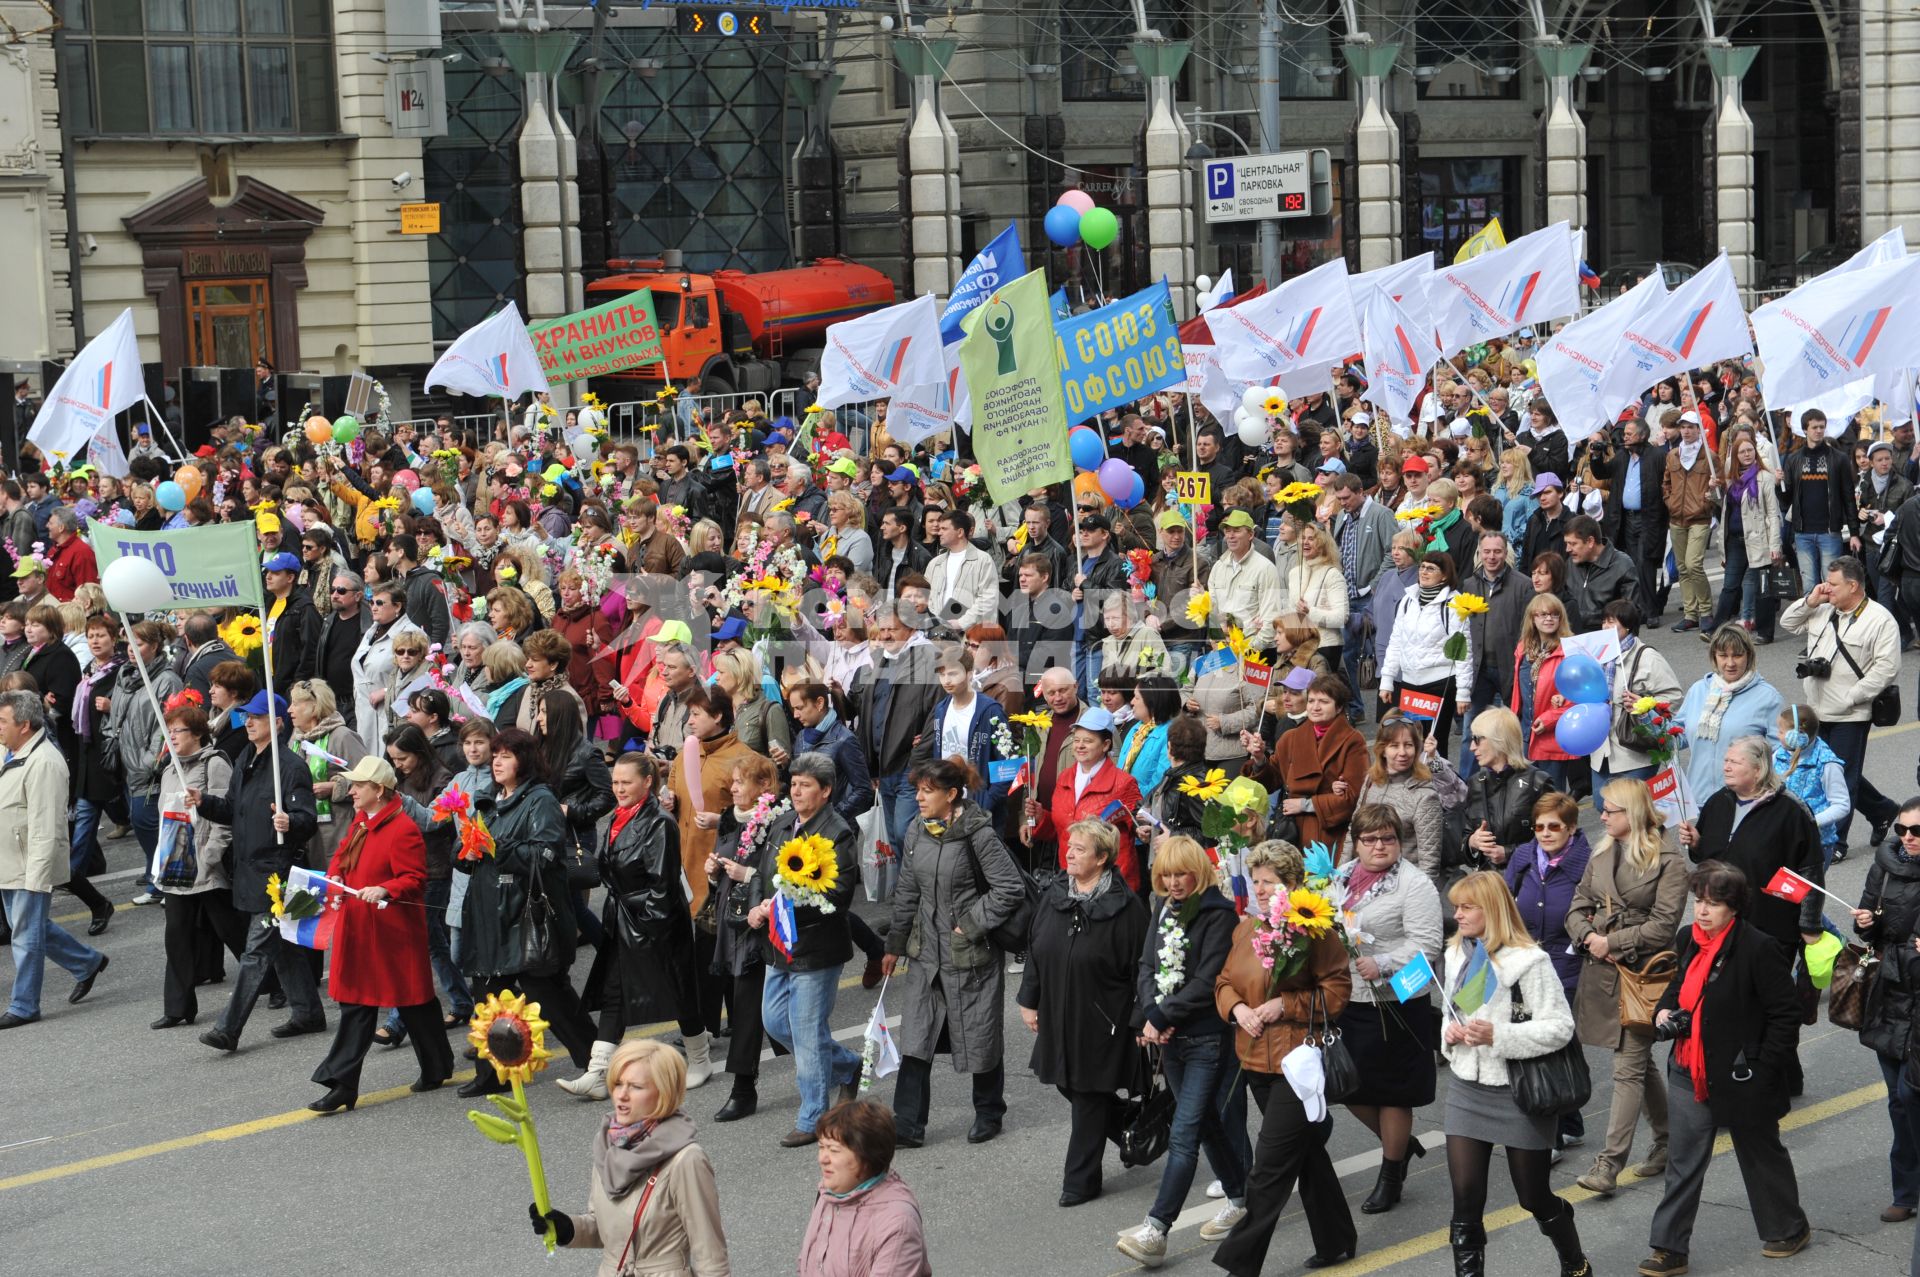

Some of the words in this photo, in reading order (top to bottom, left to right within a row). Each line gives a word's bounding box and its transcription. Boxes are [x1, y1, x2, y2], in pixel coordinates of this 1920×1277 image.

[1240, 180, 1283, 192] ПАРКОВКА
[1239, 196, 1273, 206] СВОБОДНЫХ
[1285, 195, 1303, 209] 192
[530, 304, 647, 352] ХРАНИТЬ
[1075, 304, 1156, 364] СОЮЗ
[562, 349, 578, 365] И
[579, 325, 657, 361] ВНУКОВ
[575, 362, 610, 378] БАЗЫ
[611, 345, 662, 369] ОТДЫХА
[1179, 476, 1207, 498] 267
[1246, 666, 1268, 681] МАЯ
[1403, 696, 1410, 705] 1
[1412, 697, 1439, 712] МАЯ
[1653, 774, 1674, 794] МАЯ
